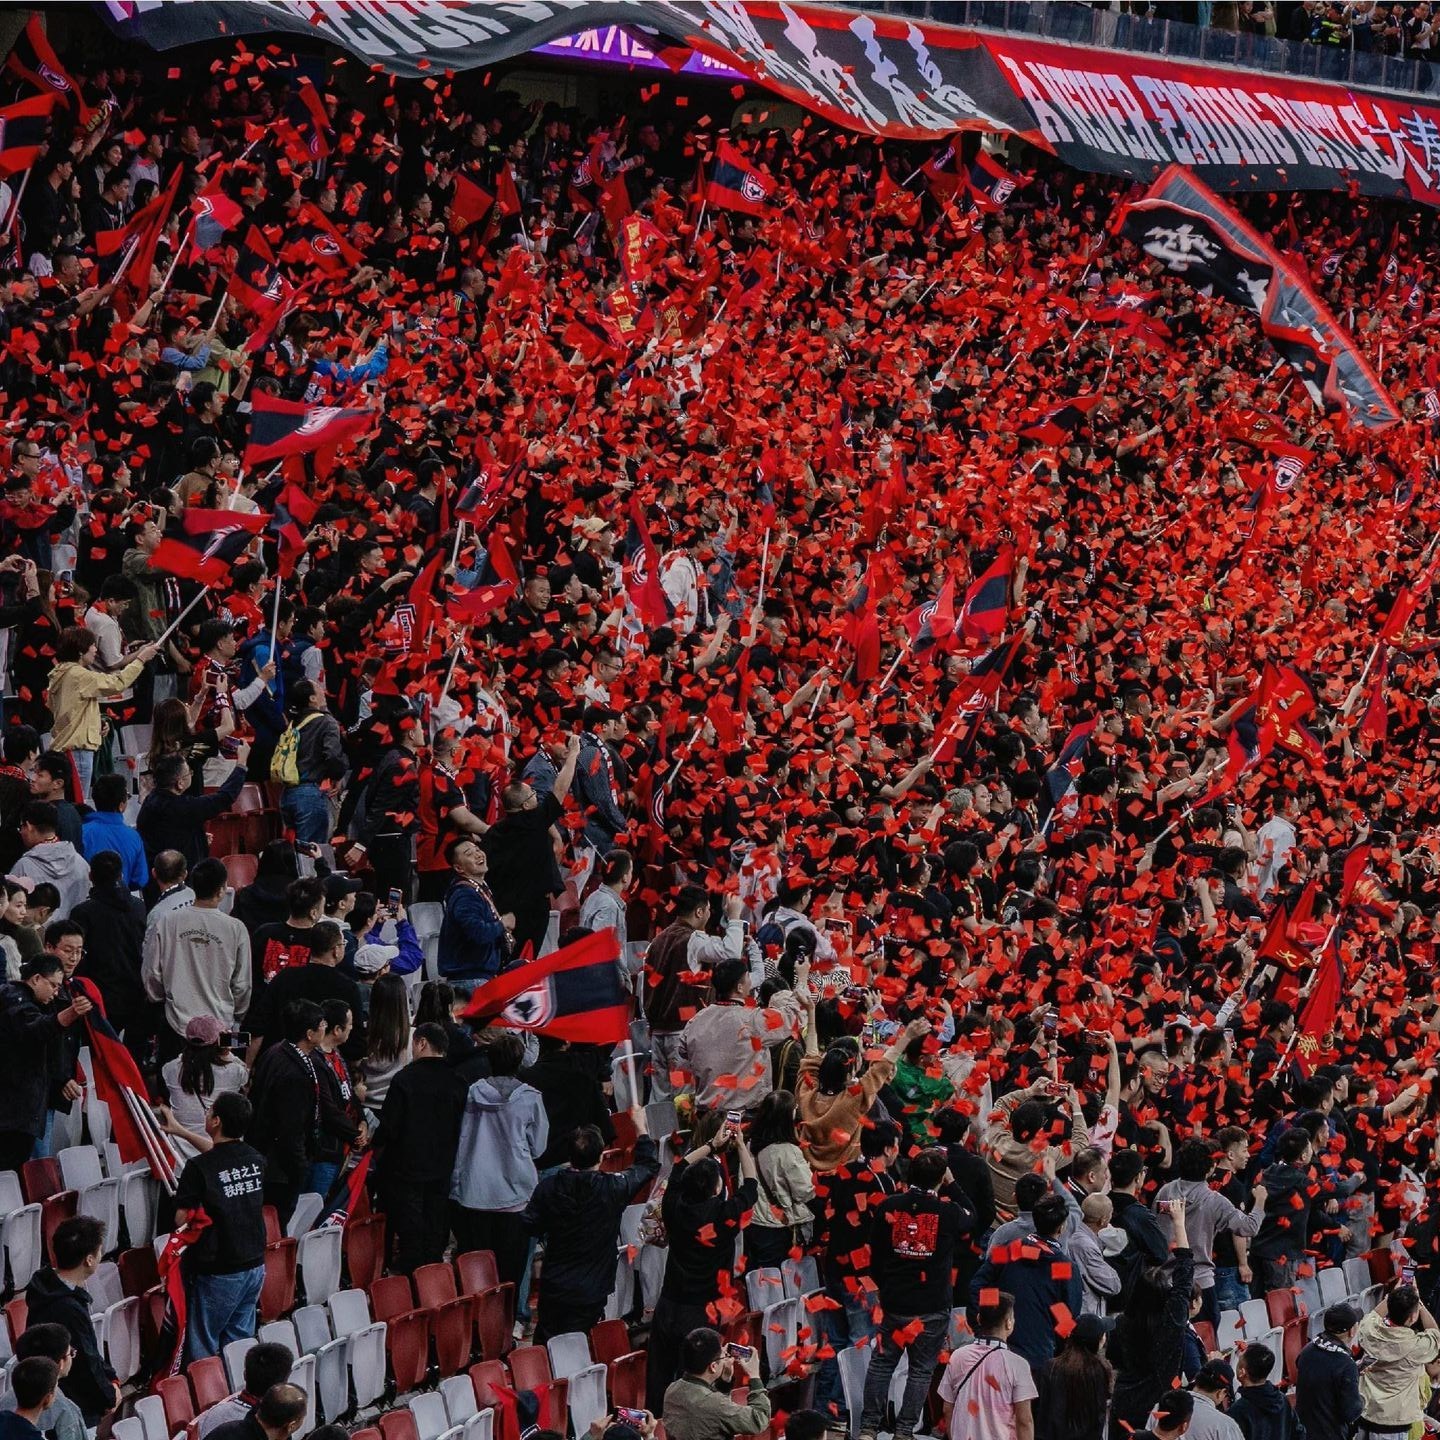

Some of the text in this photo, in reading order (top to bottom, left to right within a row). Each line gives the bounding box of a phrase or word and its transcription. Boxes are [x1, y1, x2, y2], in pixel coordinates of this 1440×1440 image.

[1025, 60, 1170, 164] NEVER
[1131, 74, 1299, 165] ENDING
[218, 1163, 262, 1183] 看台之上
[223, 1179, 263, 1198] 秩序至上
